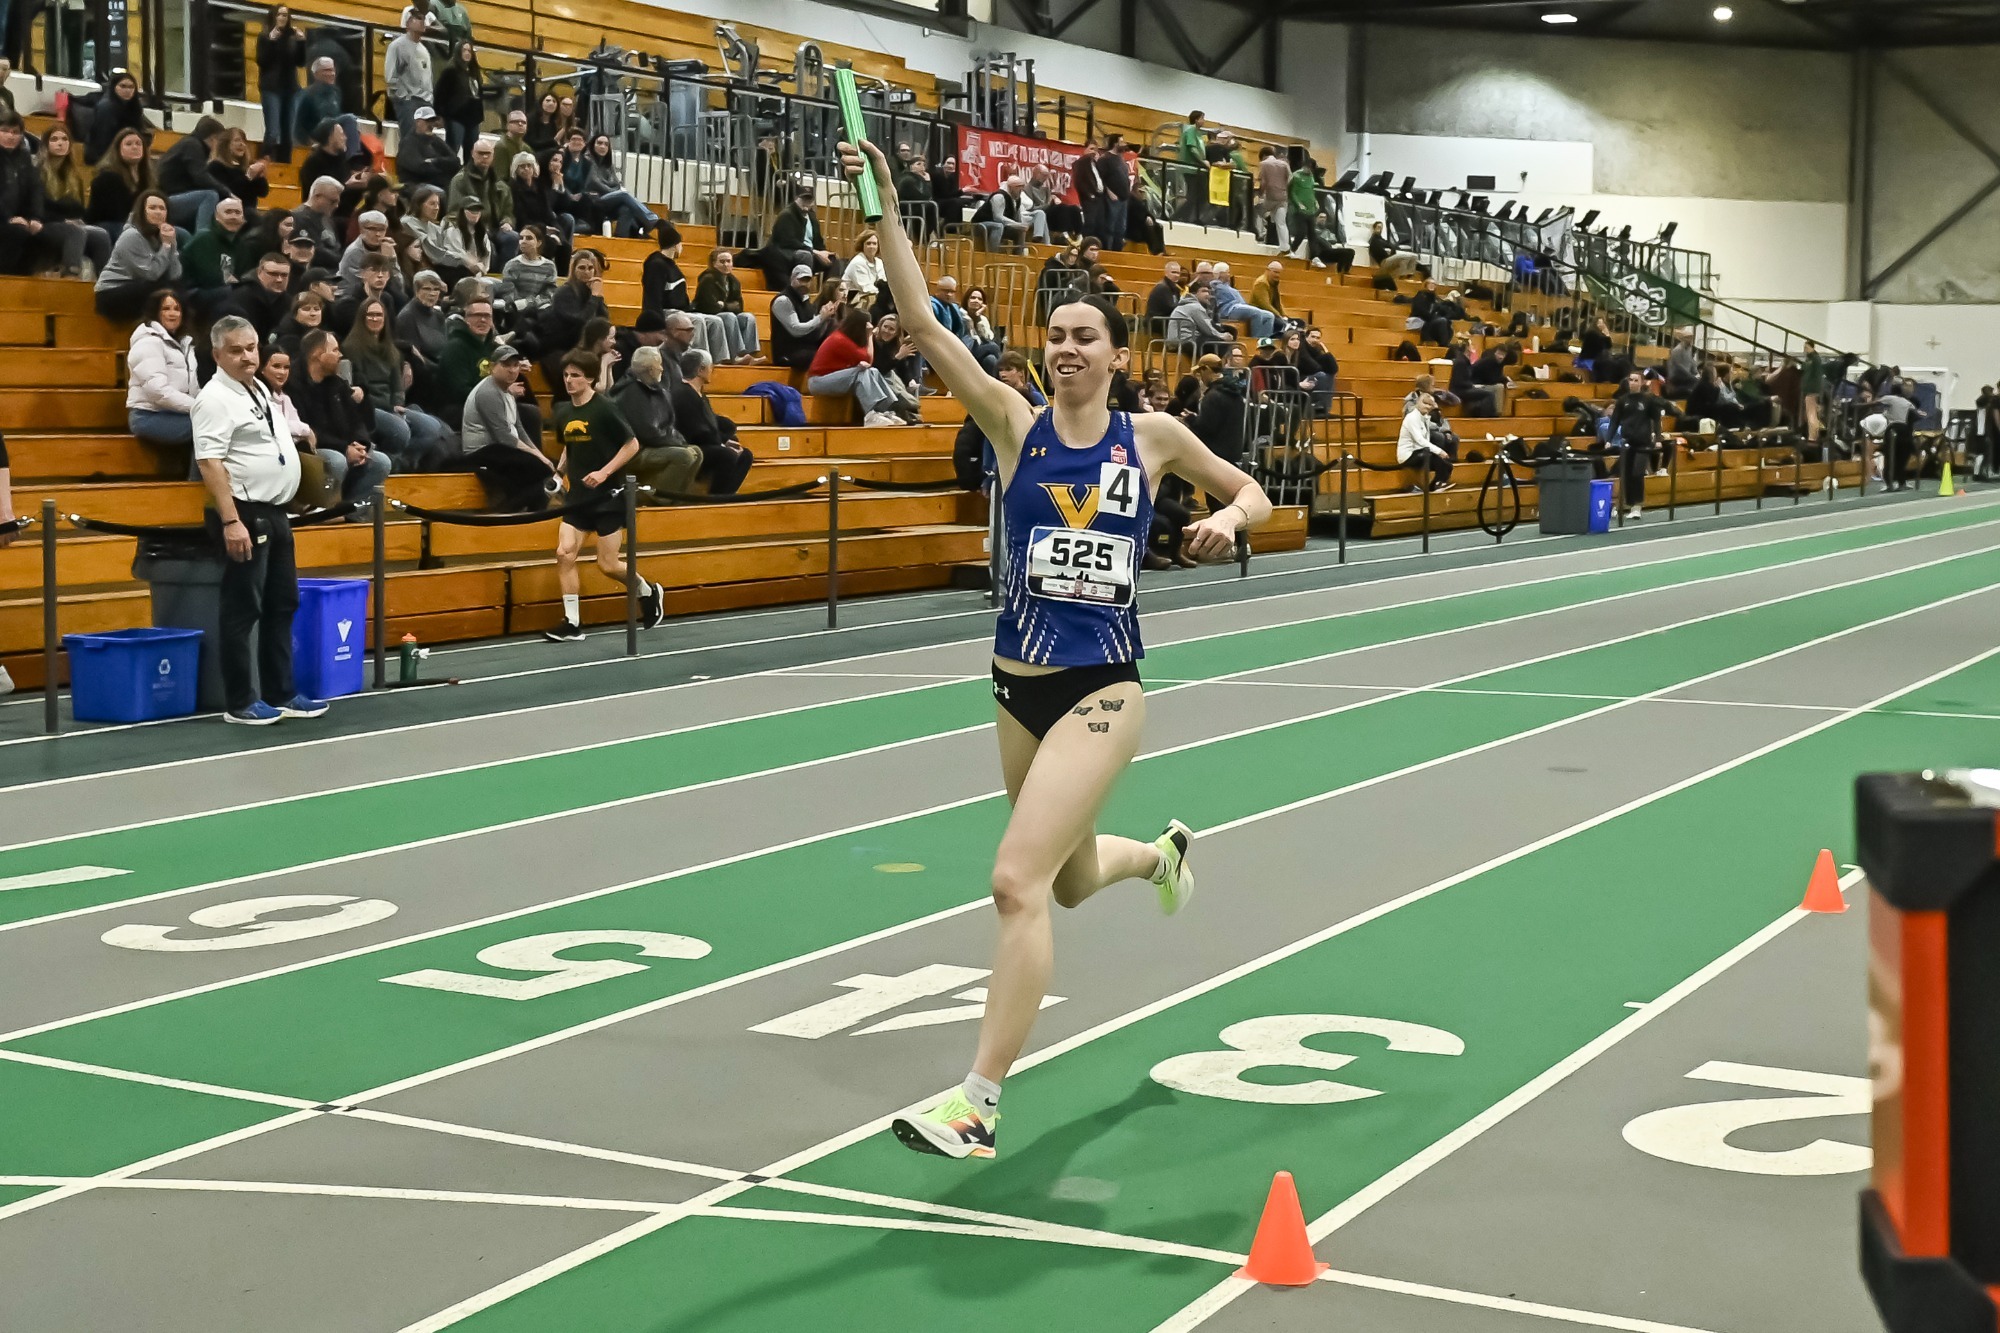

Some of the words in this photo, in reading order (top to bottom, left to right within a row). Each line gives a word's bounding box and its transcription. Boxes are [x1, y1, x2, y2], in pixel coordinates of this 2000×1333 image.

[1106, 468, 1132, 512] 4
[1049, 537, 1115, 571] 525
[379, 929, 712, 1001] 5
[746, 963, 1070, 1039] 4
[1149, 1013, 1465, 1105] 3
[1622, 1060, 1874, 1176] 2
